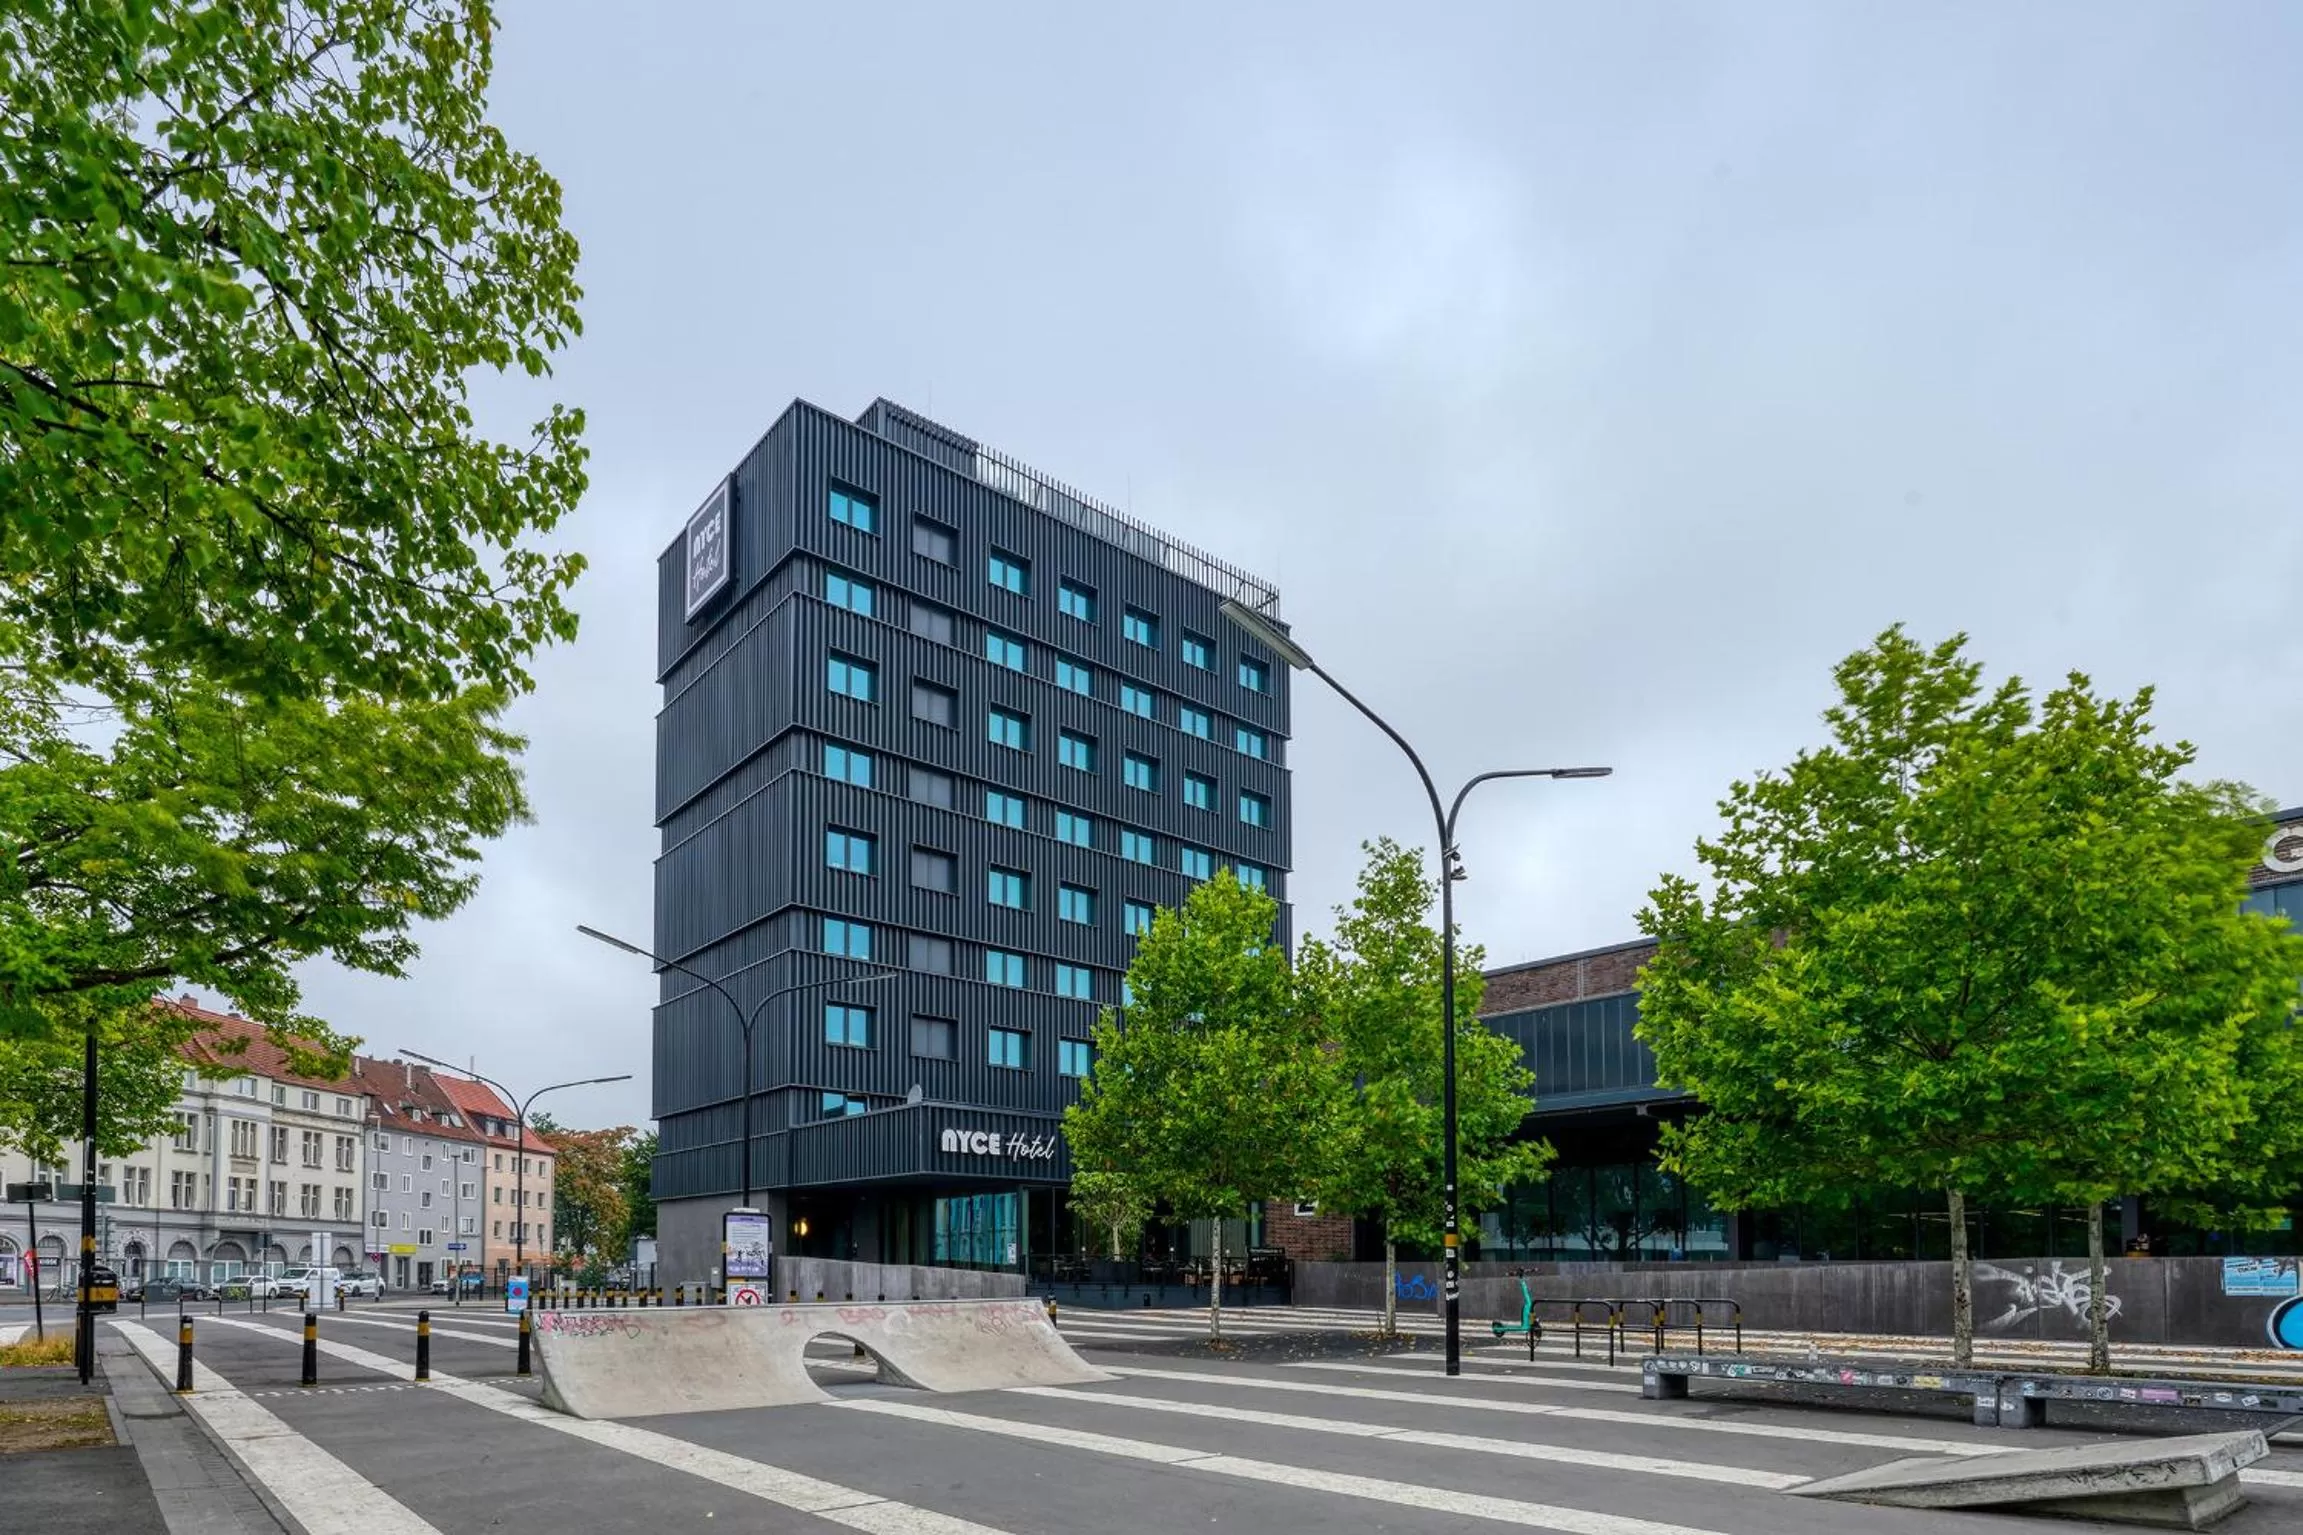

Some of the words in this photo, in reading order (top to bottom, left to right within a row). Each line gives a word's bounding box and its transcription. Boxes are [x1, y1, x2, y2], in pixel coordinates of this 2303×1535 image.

[693, 510, 721, 559] NYCE
[692, 537, 721, 593] Hotel
[941, 1129, 1001, 1156] NYCE
[1005, 1132, 1056, 1162] Hotel
